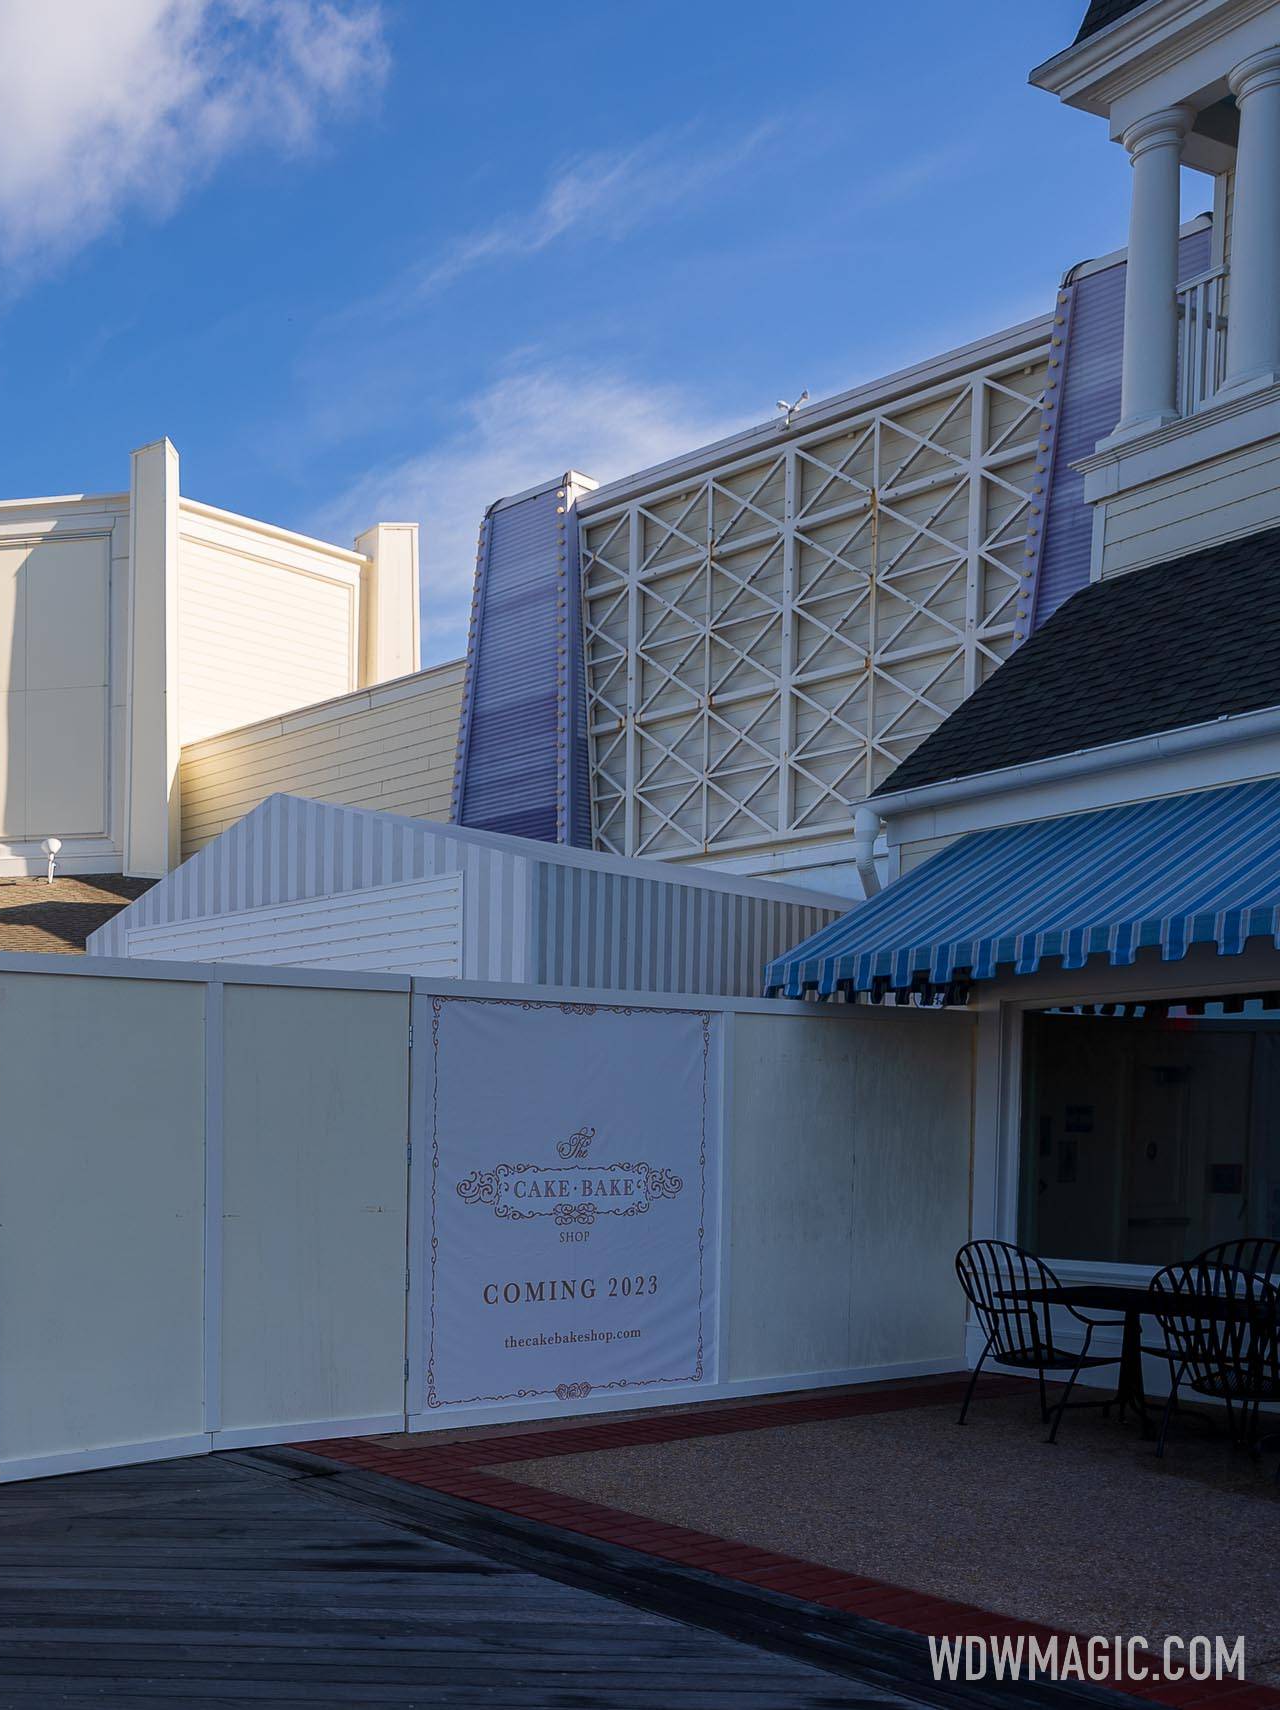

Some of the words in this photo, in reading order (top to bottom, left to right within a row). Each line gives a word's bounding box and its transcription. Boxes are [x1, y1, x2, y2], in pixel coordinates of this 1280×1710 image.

[556, 1127, 596, 1160] The
[559, 1231, 590, 1243] SHOP
[483, 1278, 597, 1305] COMING
[608, 1275, 658, 1297] 2023
[504, 1329, 641, 1349] thecakebakeshop.com
